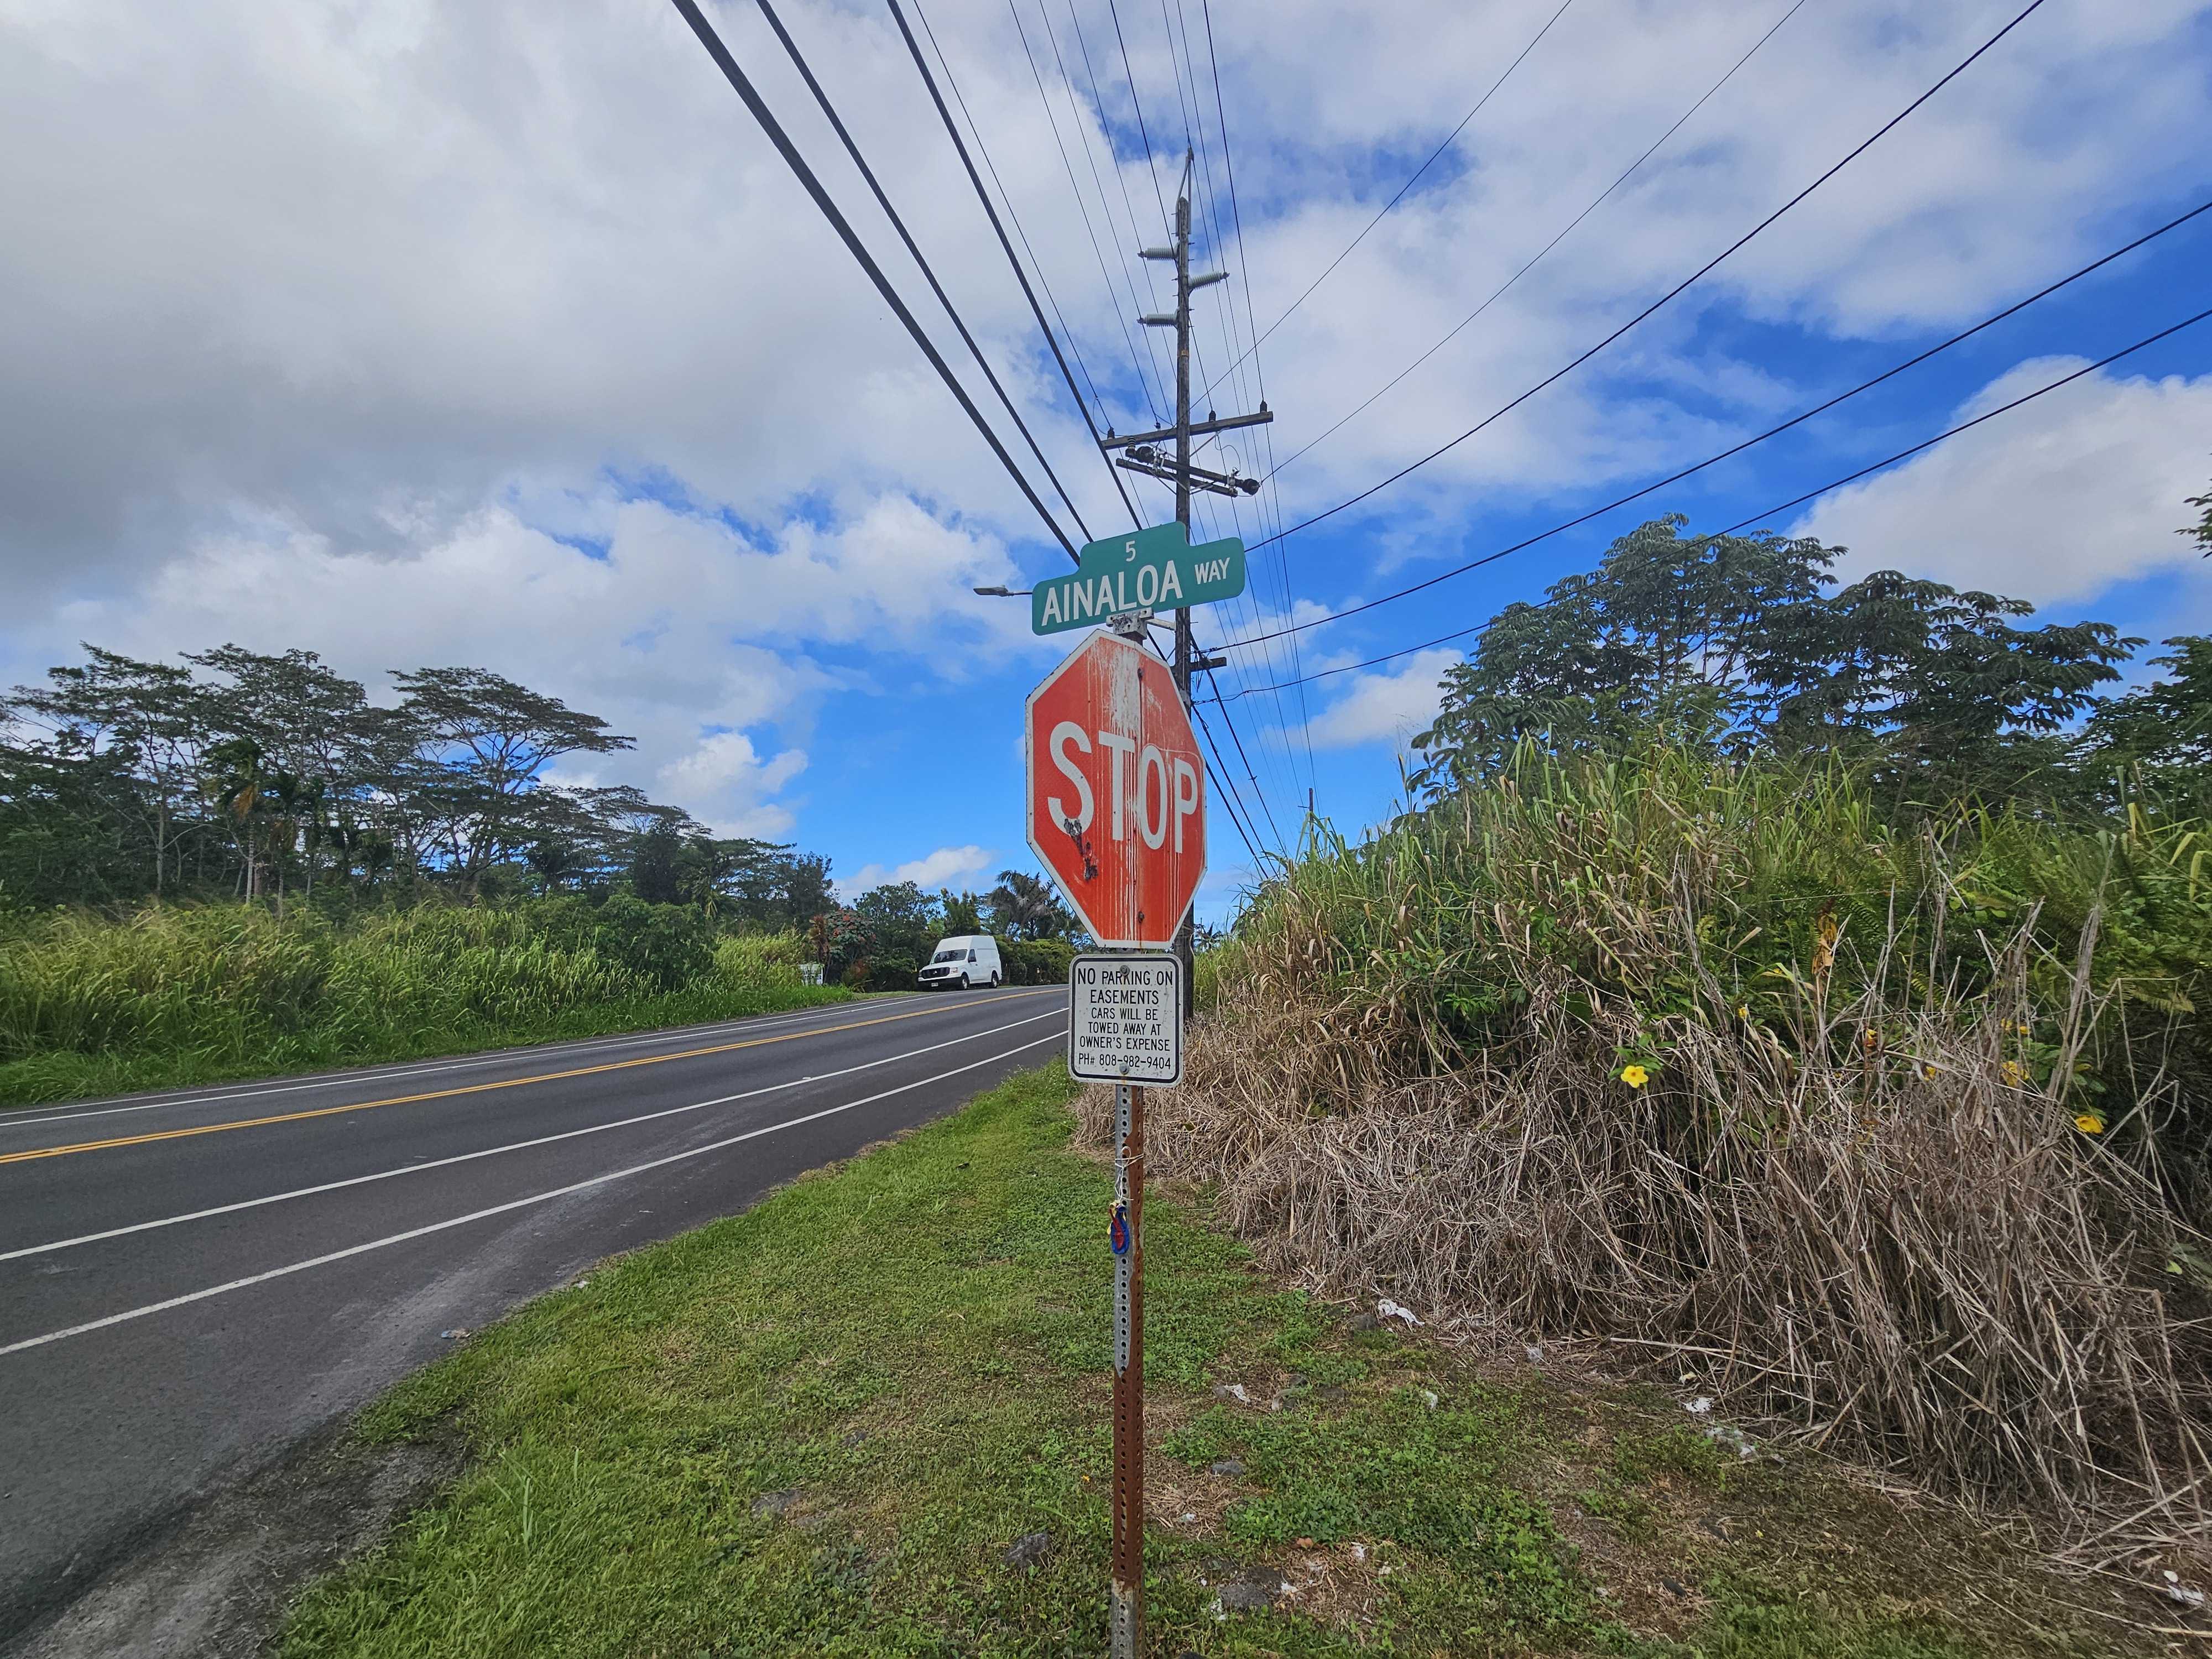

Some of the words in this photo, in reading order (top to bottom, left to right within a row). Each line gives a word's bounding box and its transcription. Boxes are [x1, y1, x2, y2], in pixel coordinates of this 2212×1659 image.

[1125, 540, 1136, 562] 5
[1041, 560, 1183, 627] AINALOA
[1194, 557, 1230, 585] WAY
[1047, 721, 1198, 854] STOP
[1078, 968, 1095, 985] NO
[1102, 971, 1150, 985] PARKING
[1156, 971, 1173, 985] ON
[1090, 989, 1159, 1005] EASEMENTS
[1091, 1008, 1115, 1019] CARS
[1120, 1008, 1141, 1020] WILL
[1145, 1009, 1158, 1020] BE
[1088, 1021, 1119, 1034] TOWED
[1123, 1022, 1146, 1035] AWAY
[1150, 1024, 1161, 1036] AT
[1079, 1036, 1121, 1049] OWNER'S
[1126, 1038, 1170, 1051] EXPENSE
[1078, 1053, 1095, 1065] PH#
[1099, 1055, 1171, 1070] 808-982-9404
